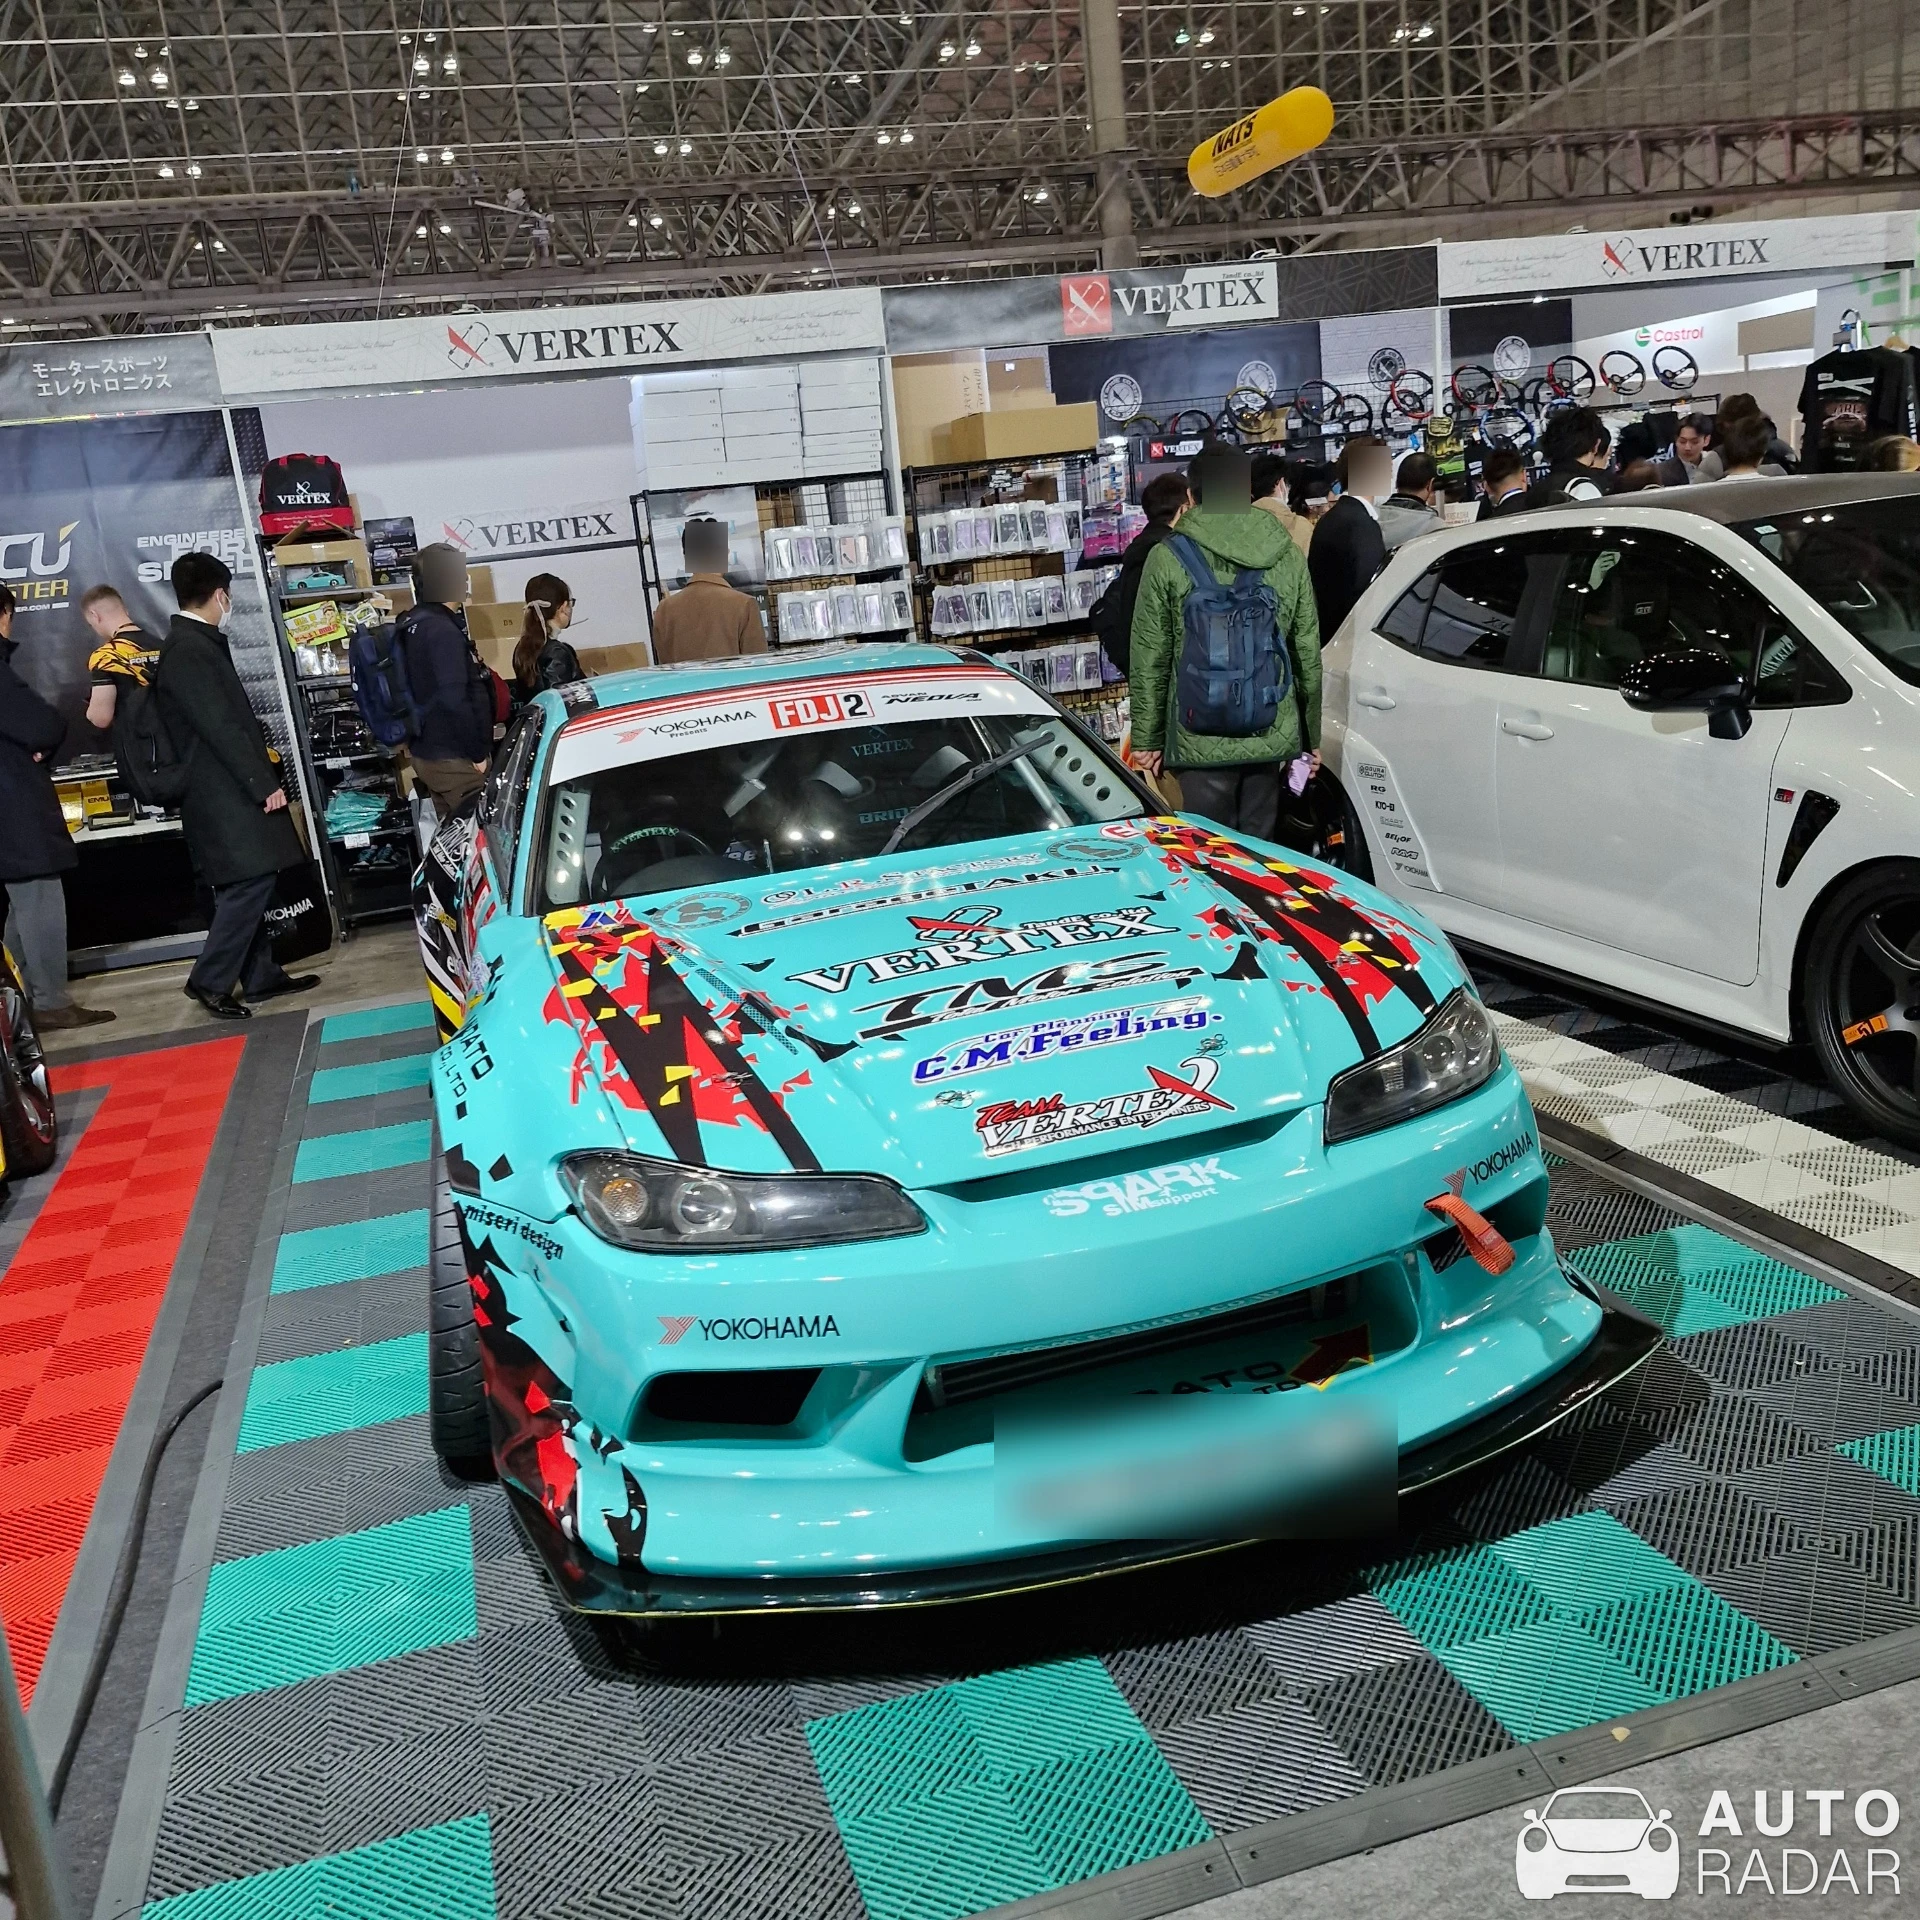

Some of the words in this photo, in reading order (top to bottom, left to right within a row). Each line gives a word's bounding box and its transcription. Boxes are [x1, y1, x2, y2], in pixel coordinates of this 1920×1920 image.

[1211, 113, 1259, 158] NATS
[1638, 238, 1770, 272] VERTEX
[1114, 277, 1266, 316] VERTEX
[495, 321, 683, 364] VERTEX
[1653, 326, 1704, 343] Castrol
[32, 355, 168, 379] モータースポーツ
[37, 373, 173, 398] エレクトロニクス
[277, 494, 332, 505] VERTEX
[479, 513, 617, 549] VERTEX
[138, 553, 256, 583] SED
[885, 692, 981, 705] NEOVA
[649, 710, 757, 736] YOKOHAMA
[669, 727, 708, 739] Presents
[851, 738, 915, 758] VERTEX
[859, 806, 918, 825] BRID
[620, 826, 668, 846] VERTEX
[789, 912, 1179, 993] VERTEX
[1030, 1009, 1131, 1035] Planning
[979, 1056, 1236, 1147] VERTEX
[1023, 1118, 1118, 1146] PERFORMANCE
[1468, 1130, 1534, 1186] YOKOHAMA
[520, 1222, 564, 1261] design
[701, 1314, 841, 1342] YOKOHAMA
